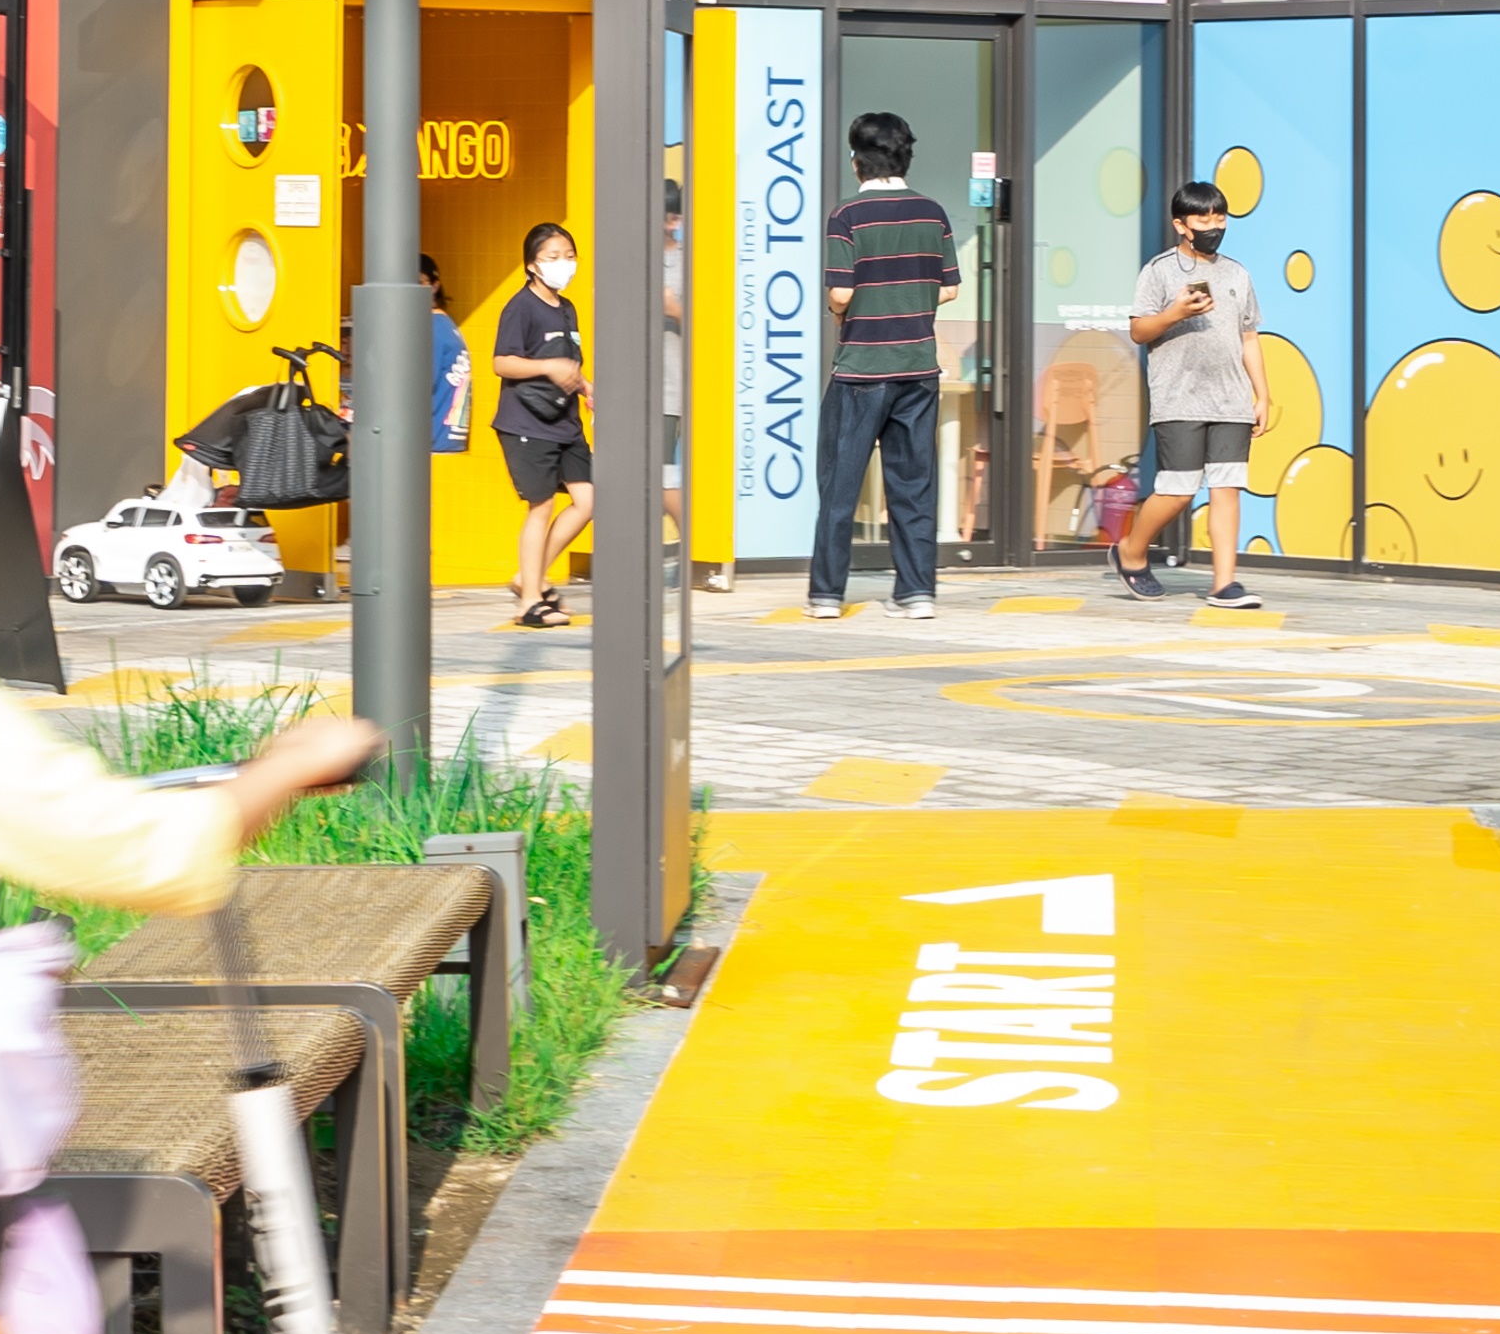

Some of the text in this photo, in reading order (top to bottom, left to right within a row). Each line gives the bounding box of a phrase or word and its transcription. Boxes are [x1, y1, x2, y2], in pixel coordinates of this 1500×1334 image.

[764, 66, 806, 501] CAMTO TOAST
[875, 942, 1120, 1111] START
